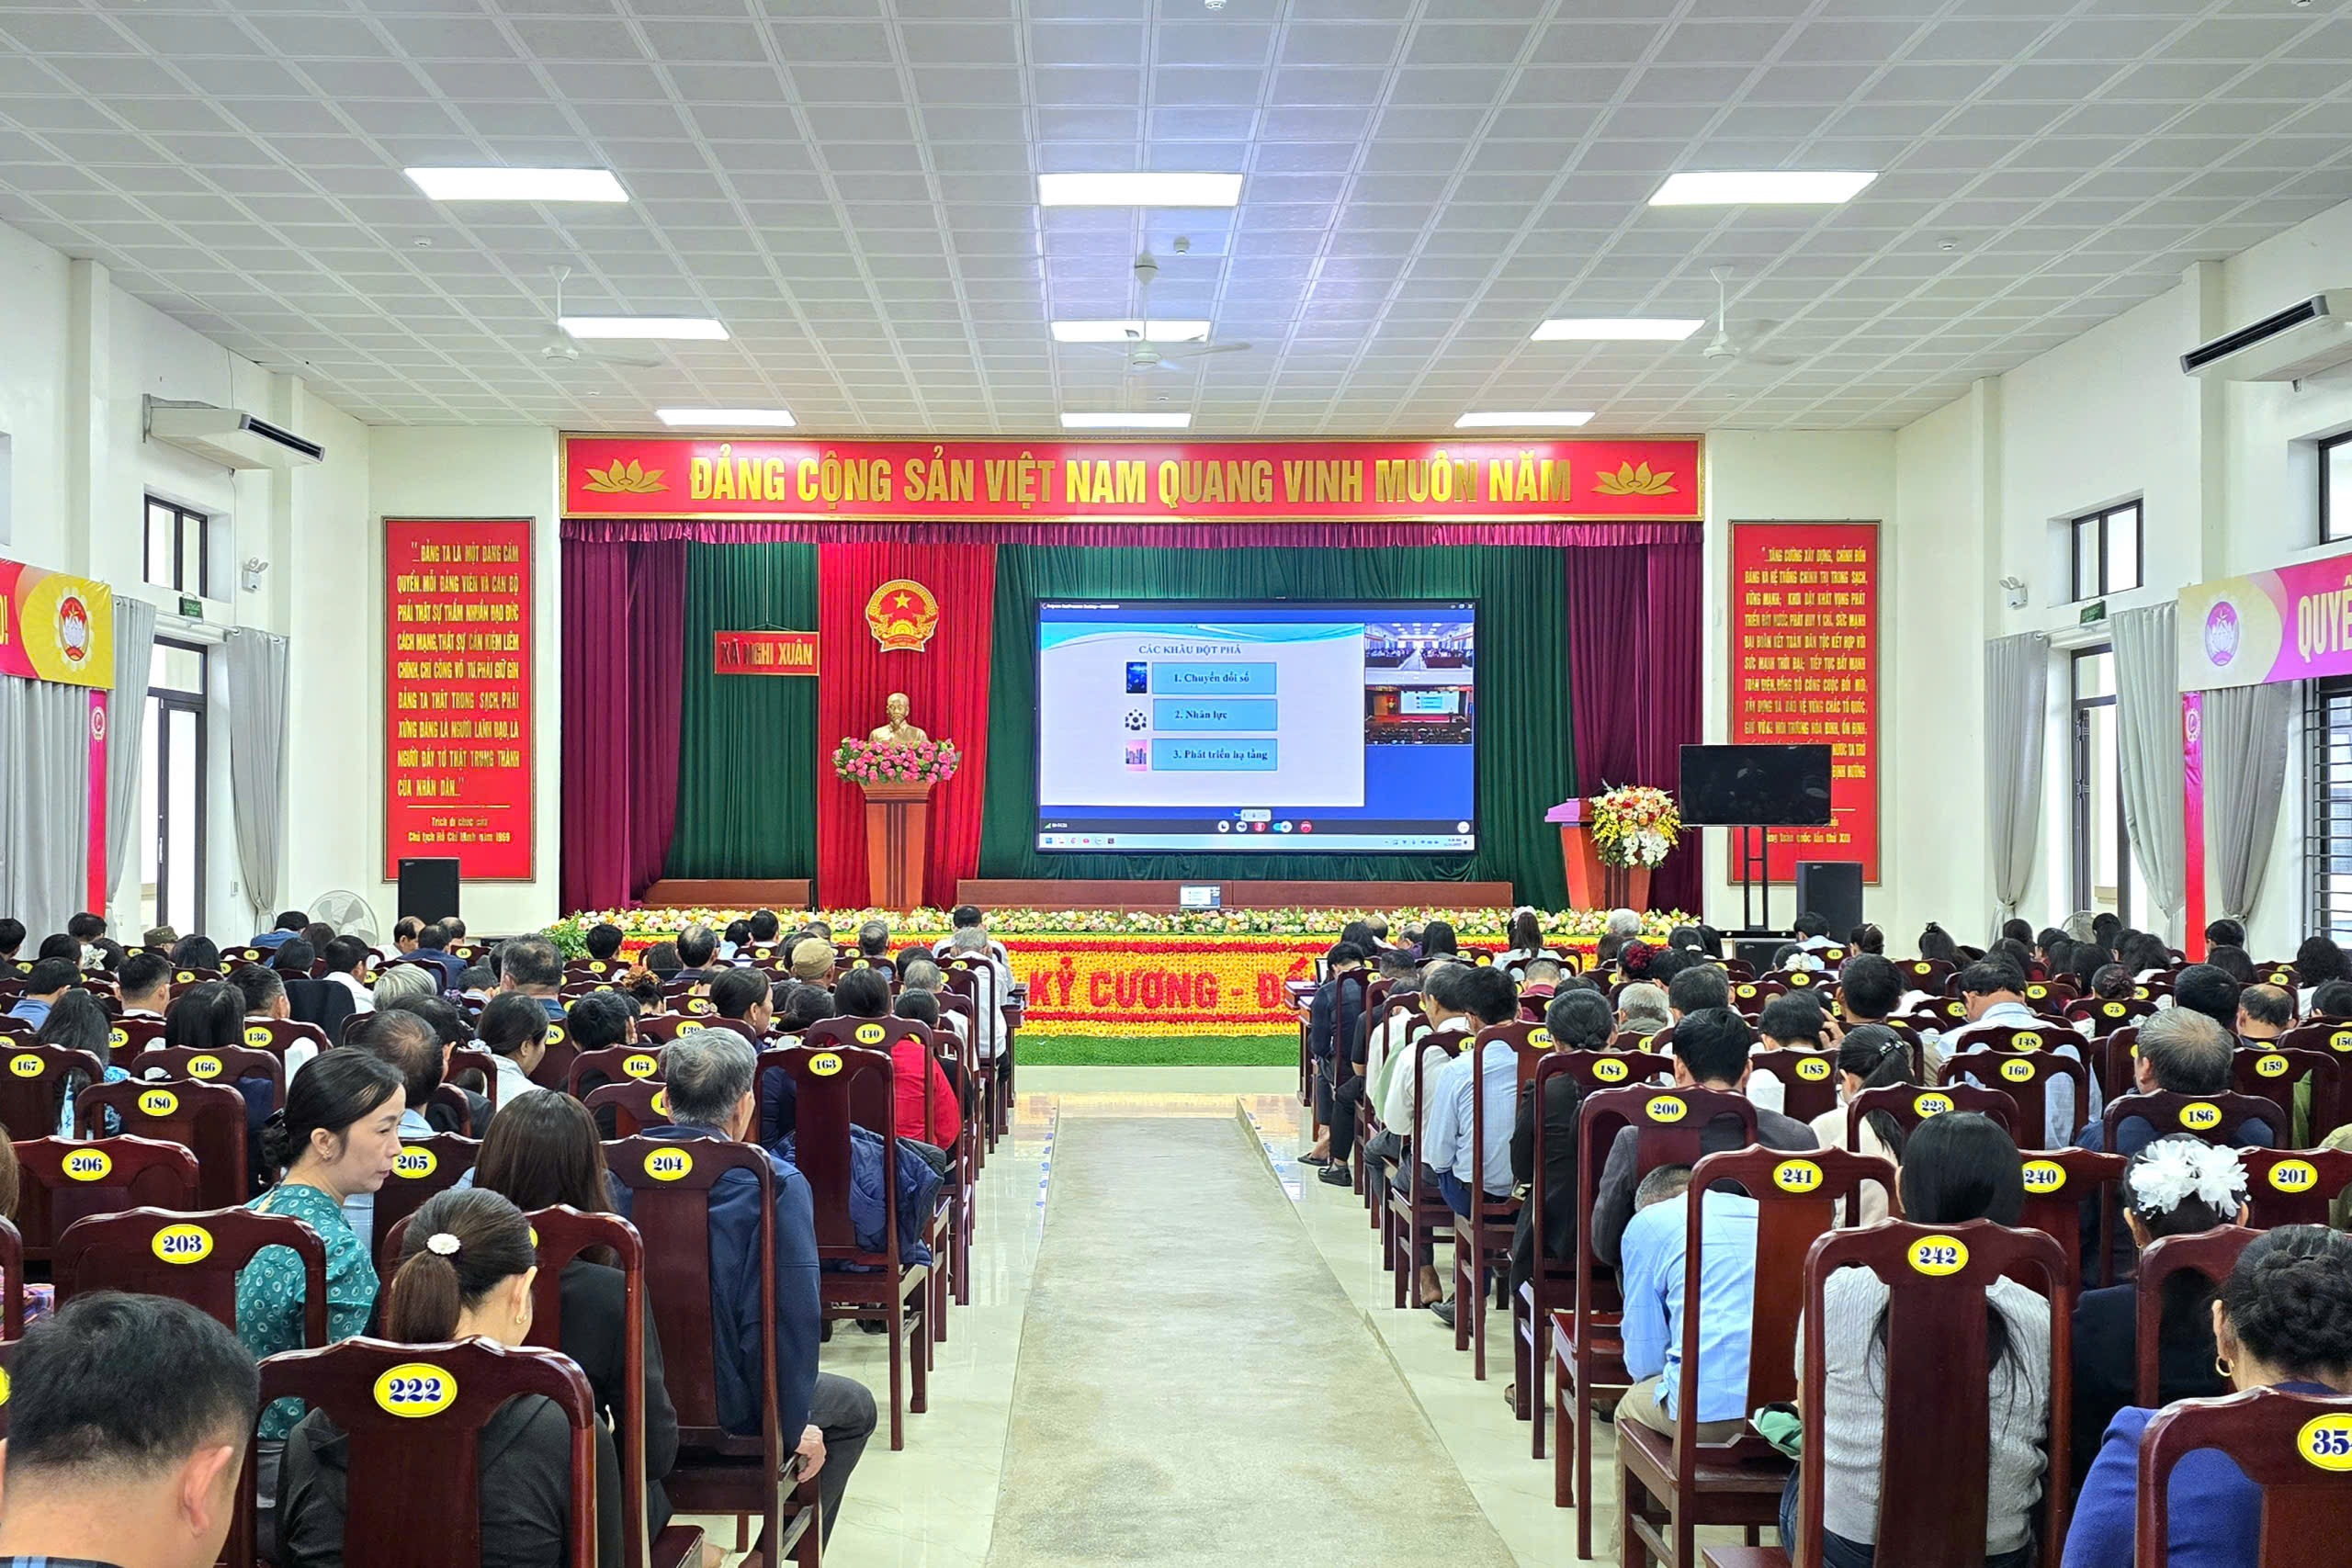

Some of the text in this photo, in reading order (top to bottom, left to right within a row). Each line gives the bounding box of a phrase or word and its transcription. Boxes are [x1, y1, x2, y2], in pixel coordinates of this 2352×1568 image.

[691, 444, 1572, 510] ĐẢNG CỘNG SẢN VIỆT NAM QUANG VINH MUÔN NĂM
[743, 641, 774, 665] NGHI
[778, 637, 813, 666] XUÂN
[1138, 643, 1160, 654] CÁC
[1163, 644, 1193, 654] KHÂU
[1174, 673, 1182, 682] 1.
[1183, 671, 1220, 684] Chuyển
[1239, 671, 1250, 682] số
[1174, 710, 1227, 720] 2. Nhân lực
[1172, 750, 1182, 759] 3.
[1184, 750, 1206, 760] Phát
[1233, 750, 1244, 761] hạ
[1030, 956, 1076, 1006] KỶ
[1090, 967, 1218, 1008] CƯƠNG
[248, 1032, 267, 1043] 136
[17, 1061, 38, 1071] 167
[195, 1062, 216, 1072] 166
[630, 1062, 650, 1071] 164
[816, 1059, 837, 1069] 163
[1600, 1065, 1621, 1075] 184
[1804, 1064, 1825, 1074] 185
[2263, 1062, 2283, 1072] 159
[2008, 1066, 2029, 1076] 160
[147, 1097, 171, 1109] 180
[1653, 1102, 1679, 1115] 200
[1922, 1100, 1946, 1113] 223
[2188, 1110, 2214, 1122] 186
[72, 1157, 103, 1172] 206
[398, 1156, 428, 1170] 205
[653, 1156, 684, 1171] 204
[1782, 1168, 1812, 1183] 241
[2025, 1169, 2057, 1184] 240
[2278, 1168, 2307, 1183] 201
[163, 1235, 202, 1253] 203
[1919, 1247, 1957, 1265] 242
[389, 1378, 442, 1403] 222
[2312, 1428, 2352, 1455] 35
